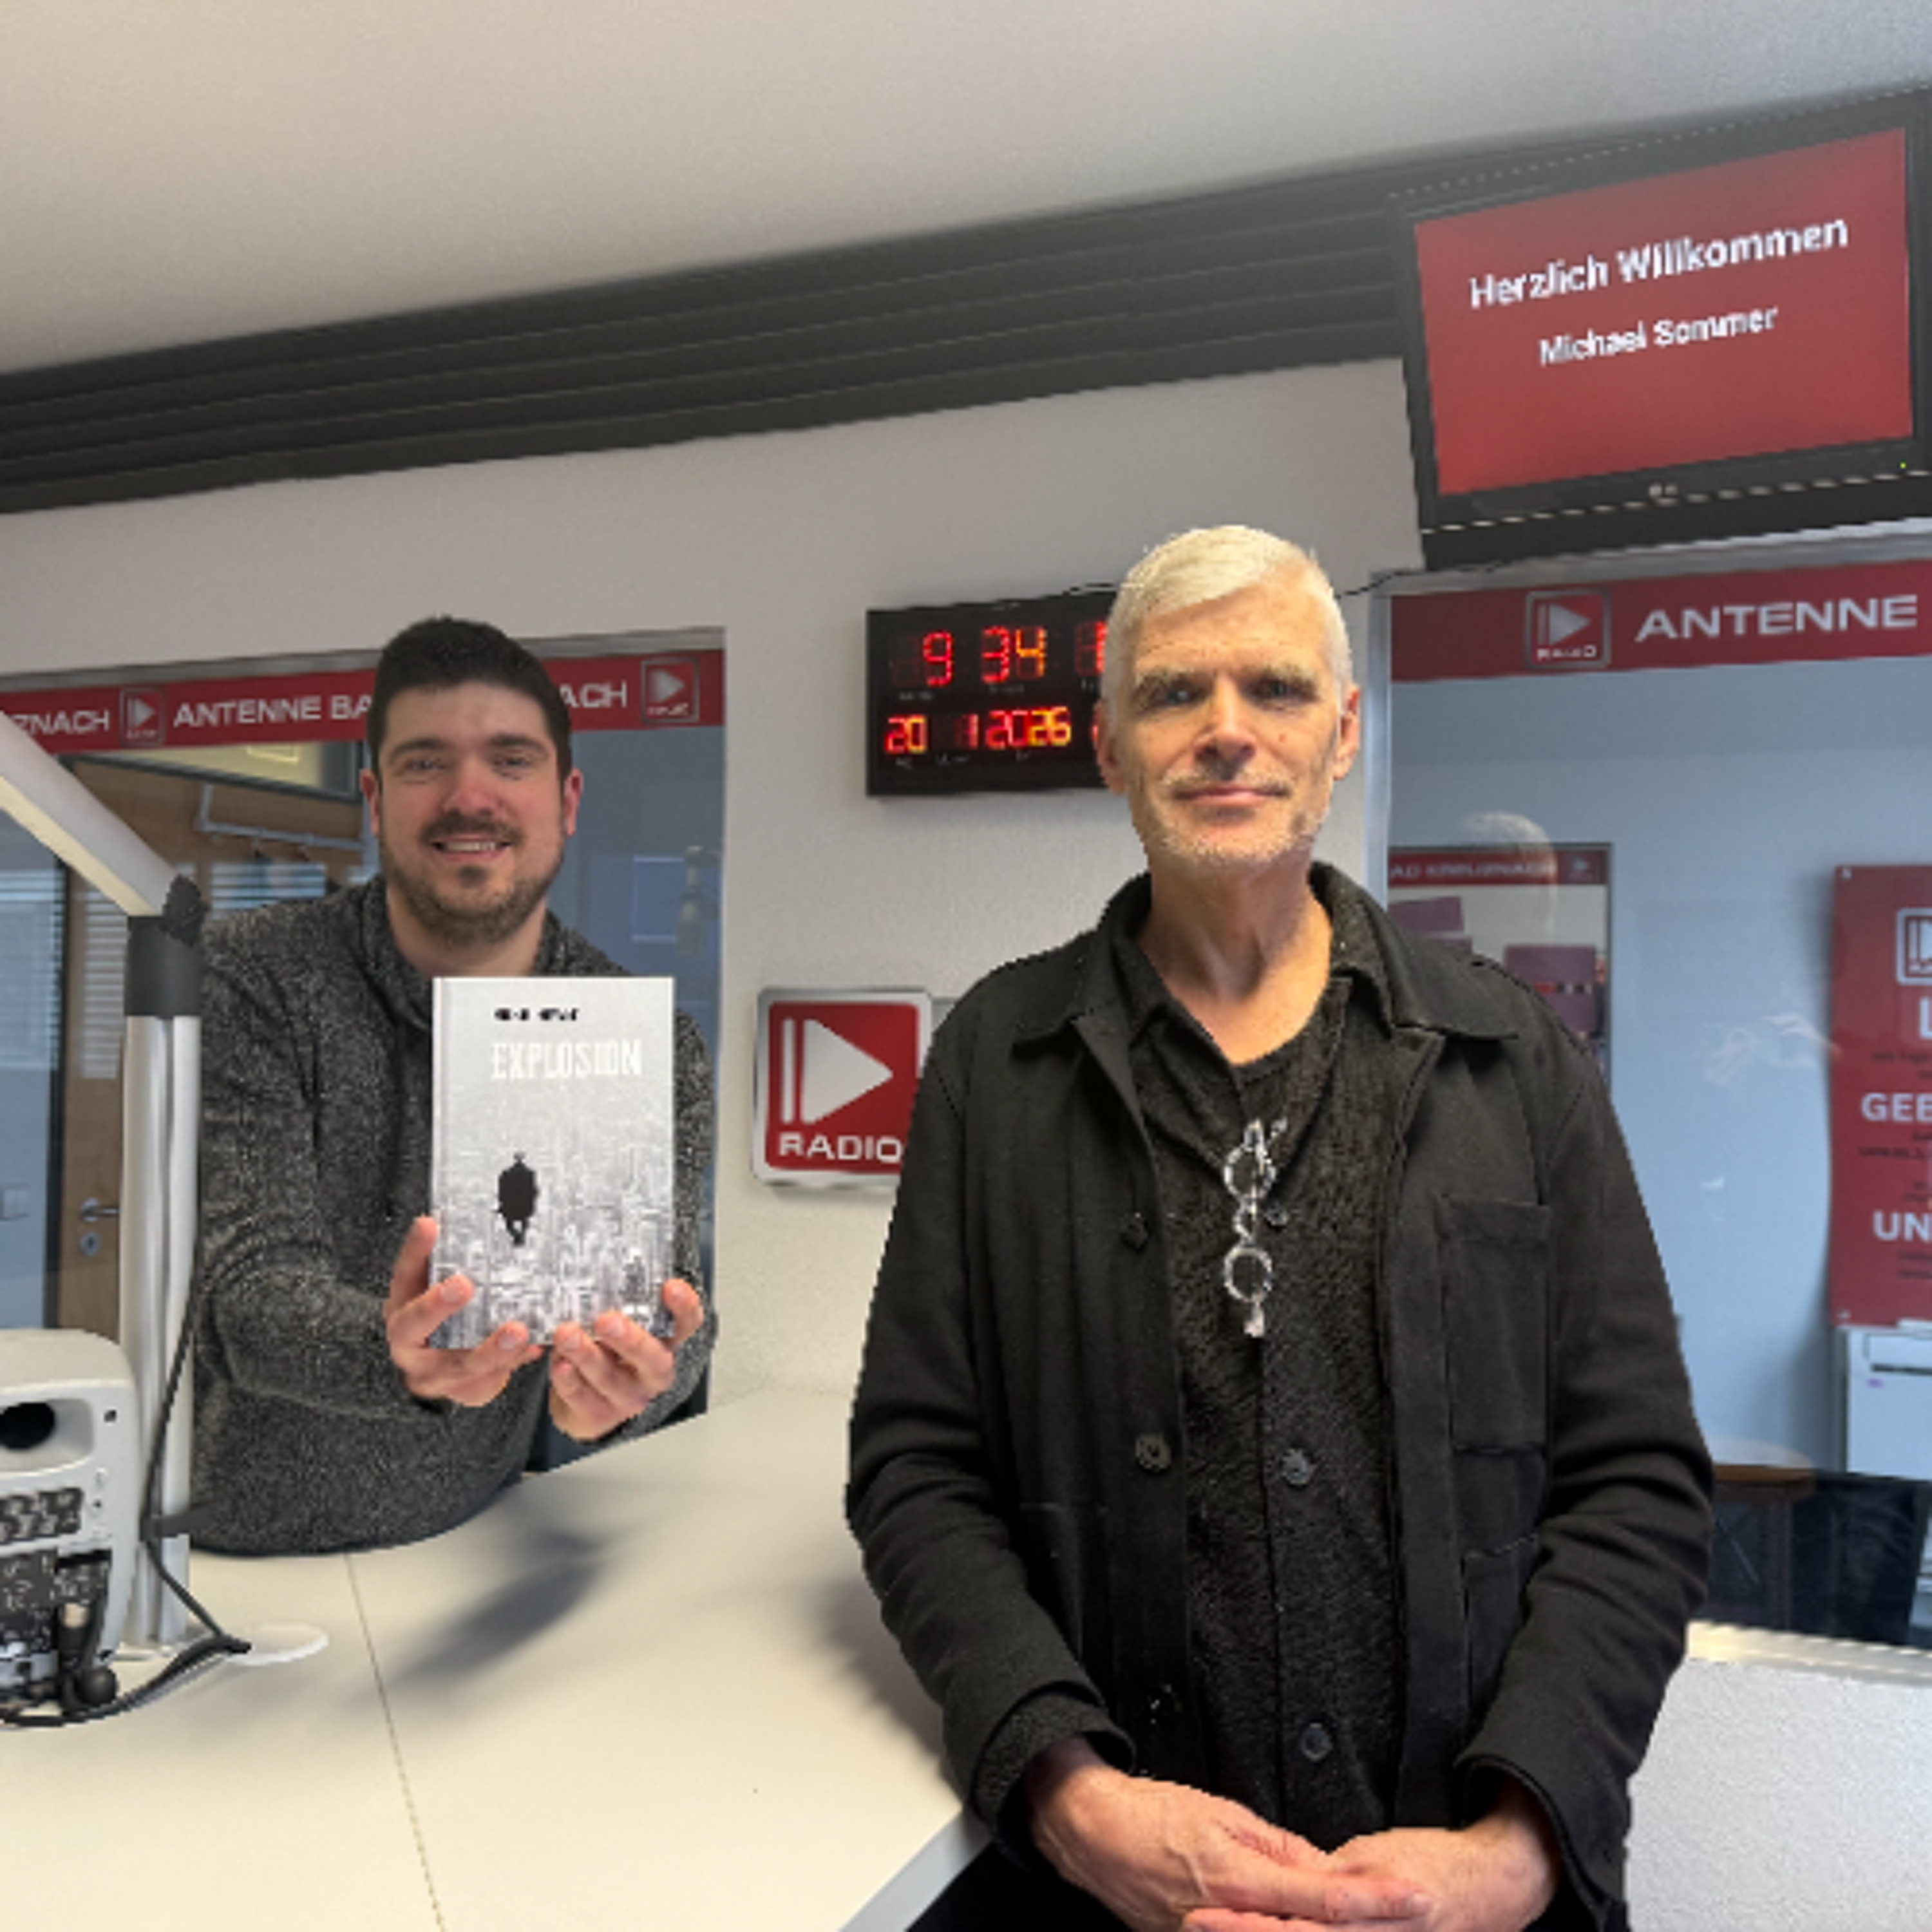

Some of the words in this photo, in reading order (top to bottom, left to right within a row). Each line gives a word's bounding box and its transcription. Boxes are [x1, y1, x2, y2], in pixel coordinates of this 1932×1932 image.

[1469, 254, 1609, 309] Herzlich
[1616, 219, 1848, 283] Willkommen
[1539, 321, 1647, 366] Michael
[1653, 307, 1778, 347] Sommer
[1634, 594, 1918, 643] ANTENNE
[922, 630, 955, 687] 9
[981, 625, 1048, 685] 34
[173, 695, 321, 728] ANTENNE
[884, 714, 927, 755] 20
[985, 705, 1072, 750] 2026
[491, 1038, 642, 1081] EXPLOSION
[779, 1131, 903, 1164] RADIO
